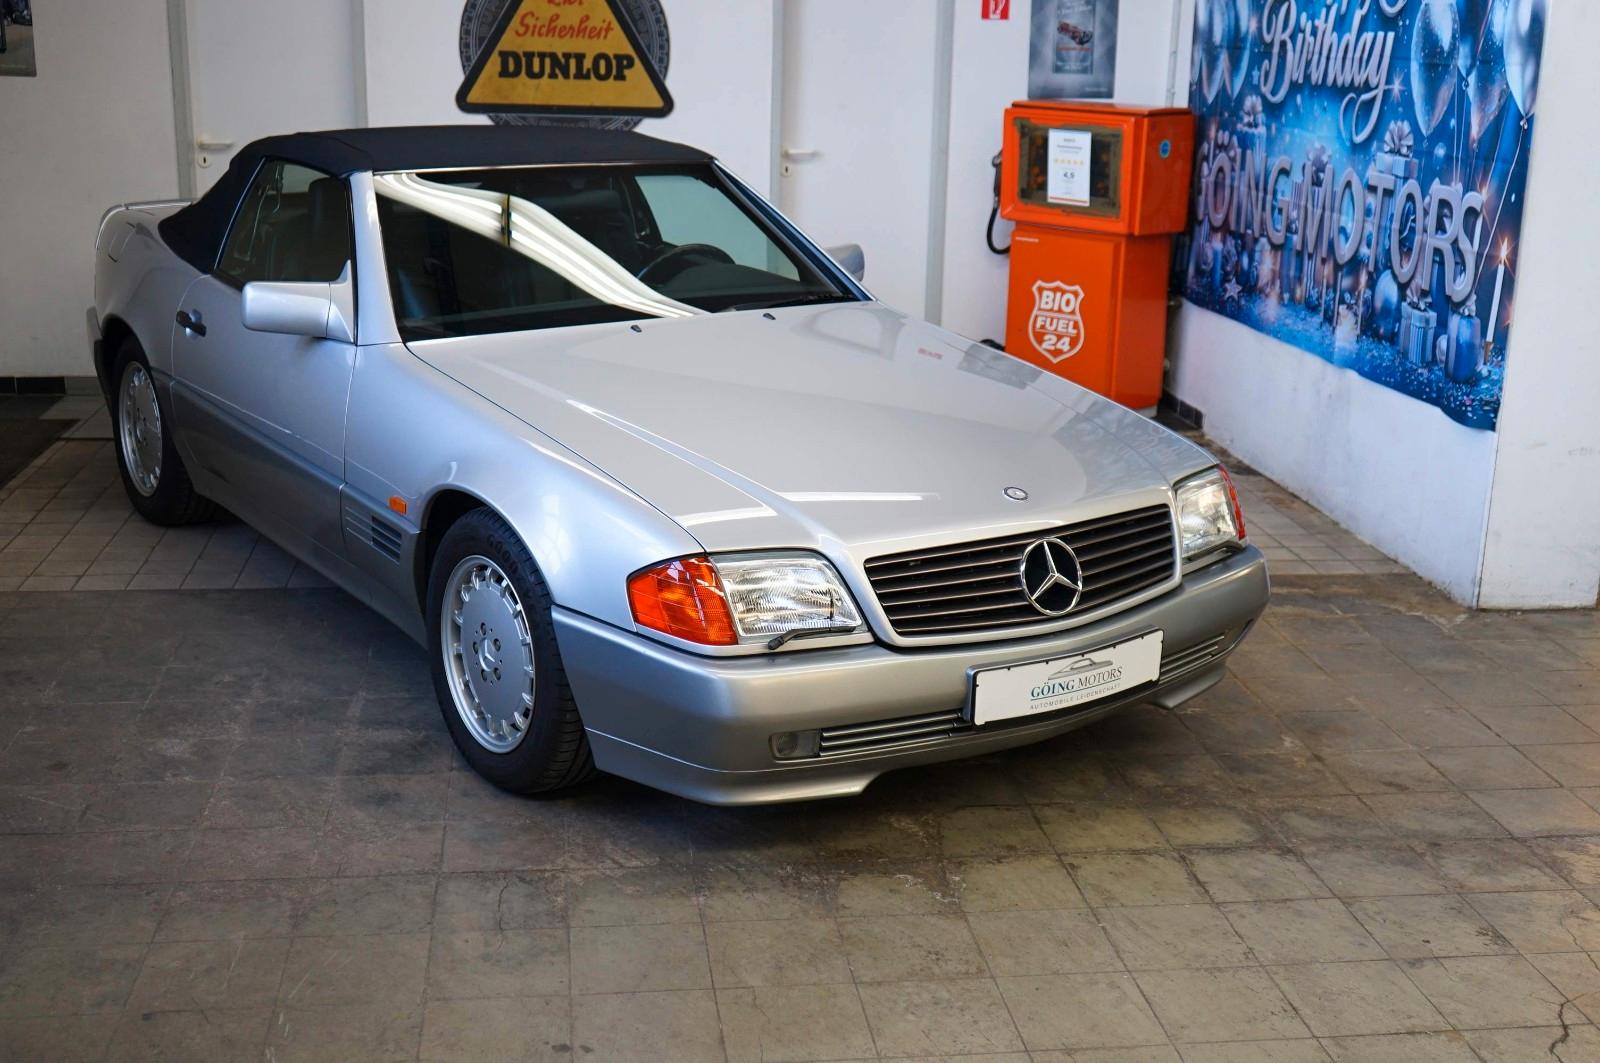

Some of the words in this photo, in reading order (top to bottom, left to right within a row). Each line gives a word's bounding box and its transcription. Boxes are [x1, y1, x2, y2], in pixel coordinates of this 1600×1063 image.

[515, 11, 615, 40] Sicherheit
[498, 50, 636, 81] DUNLOP
[1260, 0, 1396, 145] Birthday
[1194, 129, 1291, 245] GÖING
[1296, 161, 1484, 302] MOTORS
[1040, 289, 1075, 312] BIO
[1036, 316, 1077, 334] FUEL
[1042, 334, 1070, 352] 24
[1030, 696, 1074, 710] AUTOMOBILE
[1076, 683, 1121, 701] LEIDENSCHAFT
[1031, 680, 1075, 698] GÖING
[1078, 666, 1122, 688] MOTORS
